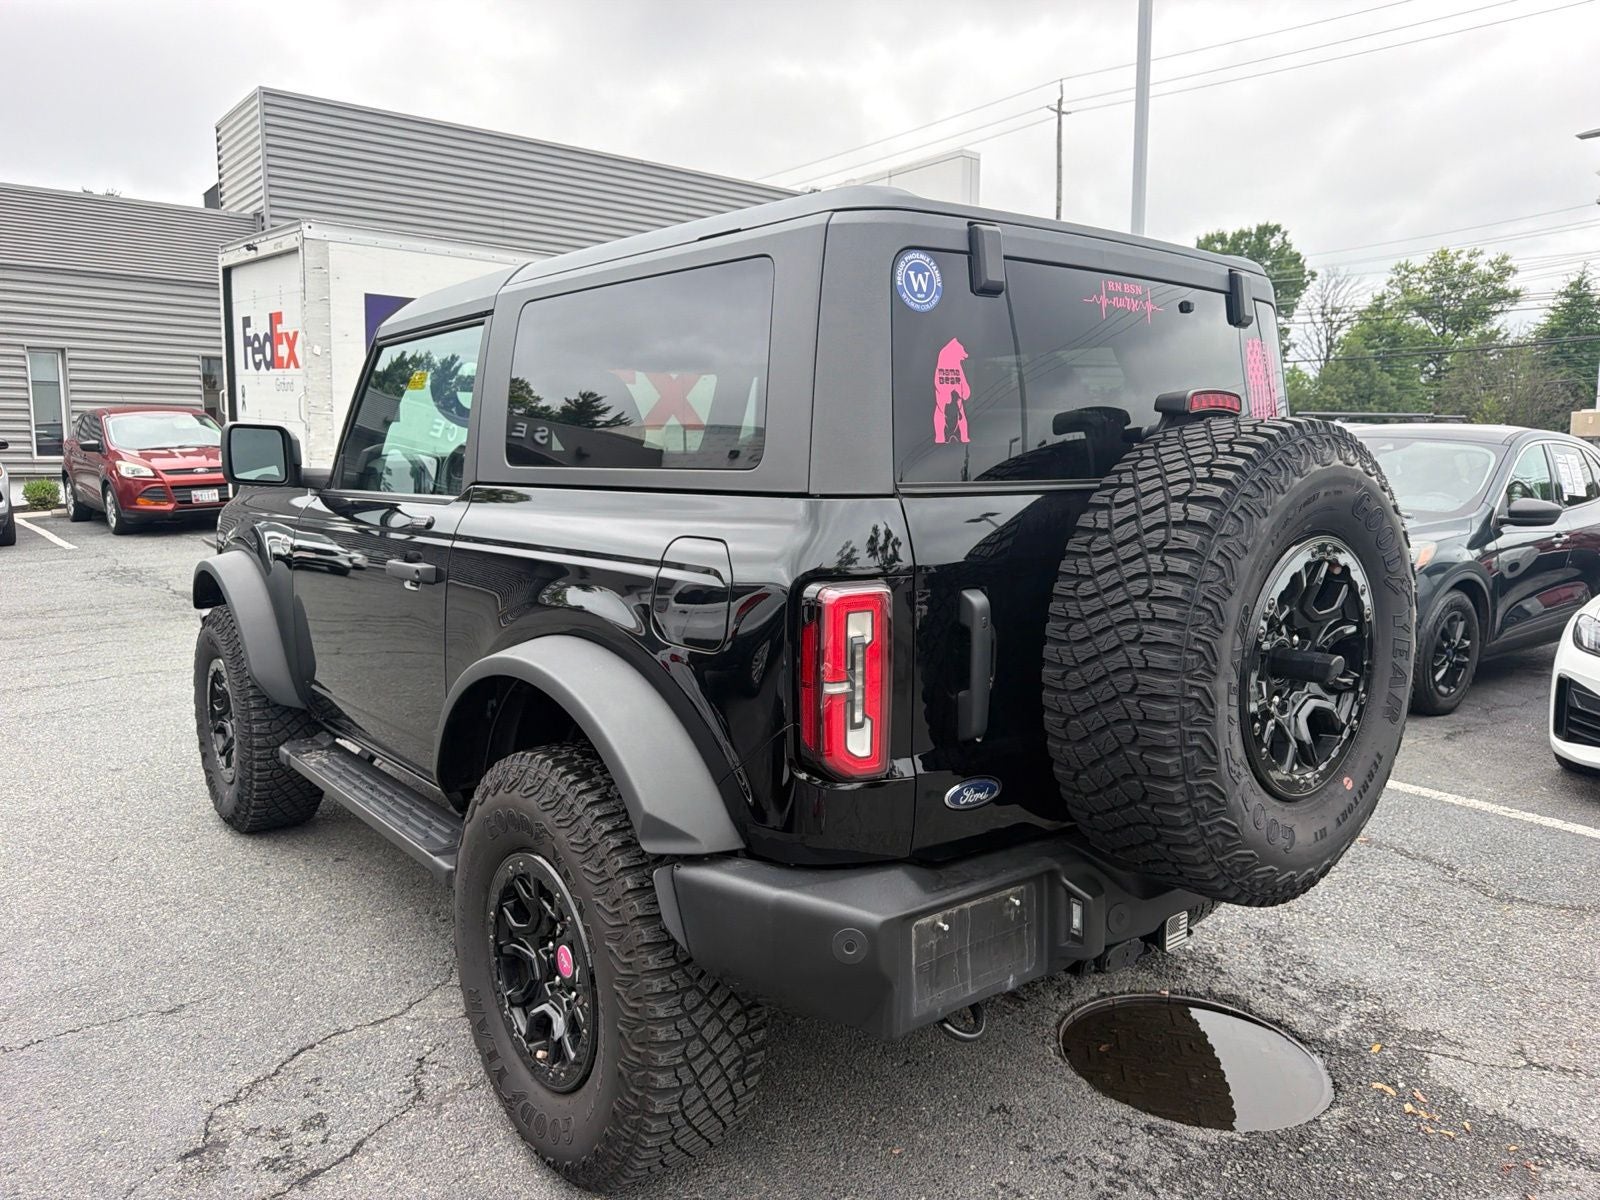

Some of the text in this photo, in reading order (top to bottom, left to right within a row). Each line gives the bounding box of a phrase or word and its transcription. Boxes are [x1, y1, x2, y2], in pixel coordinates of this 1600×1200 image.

[904, 252, 931, 264] PHOENIX
[908, 270, 930, 293] W
[1107, 280, 1143, 295] RN BSN
[241, 311, 301, 371] FedEx
[959, 786, 990, 805] Ford
[1336, 752, 1384, 828] TERRITORY
